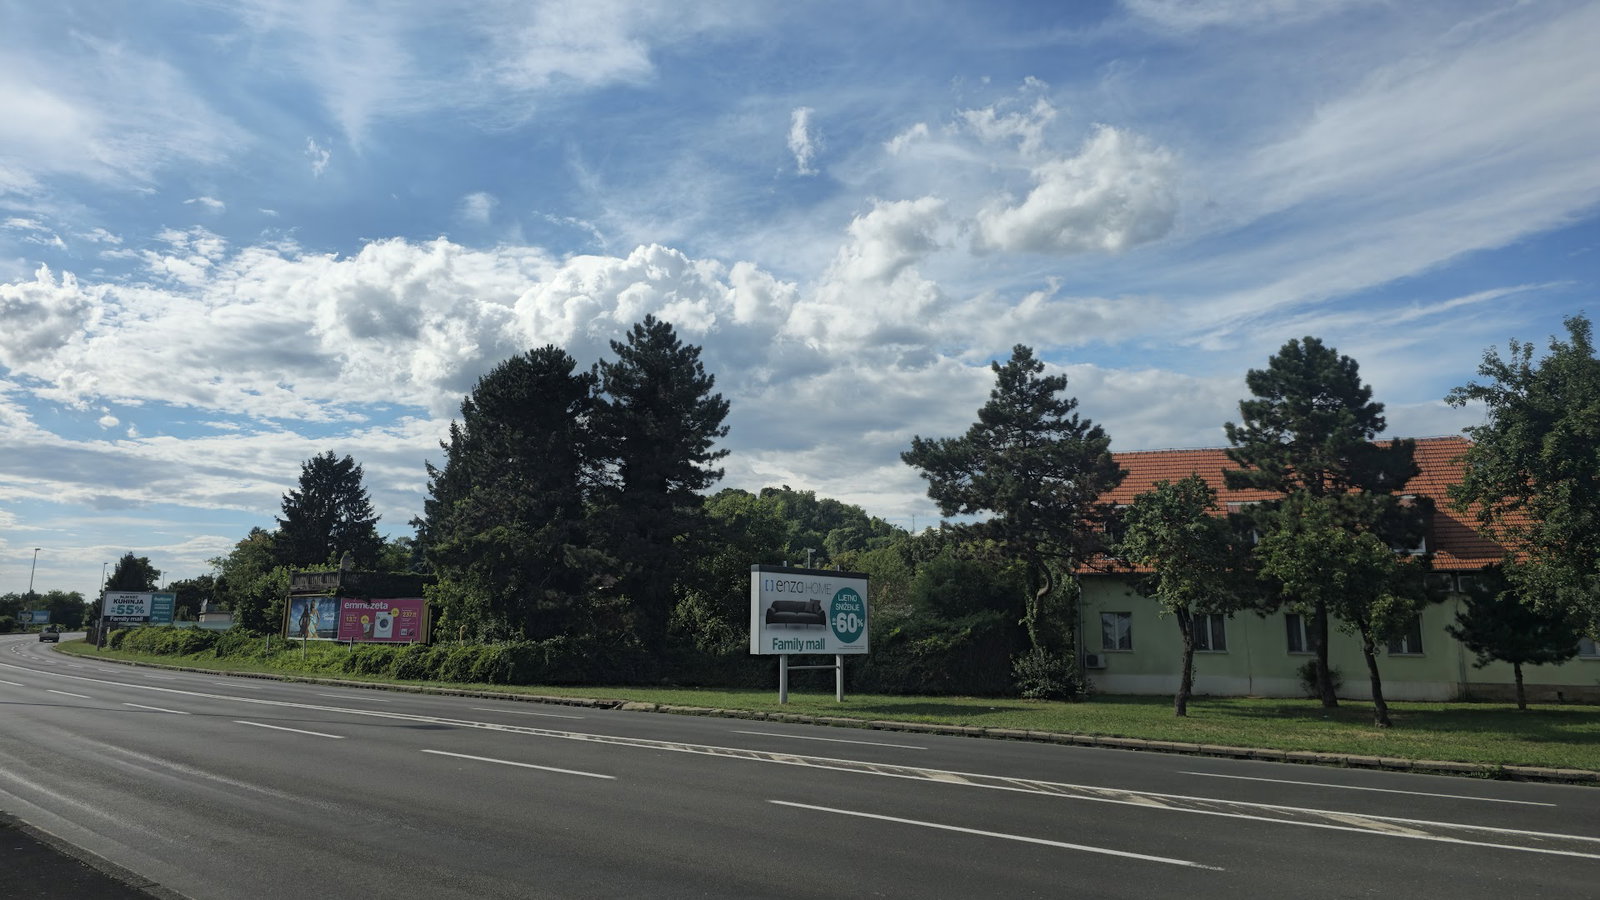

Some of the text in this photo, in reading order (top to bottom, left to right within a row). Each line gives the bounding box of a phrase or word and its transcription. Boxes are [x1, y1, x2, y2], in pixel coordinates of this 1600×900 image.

[805, 582, 832, 595] HOME
[837, 594, 857, 602] LJETNO
[772, 637, 825, 652] Family mall
